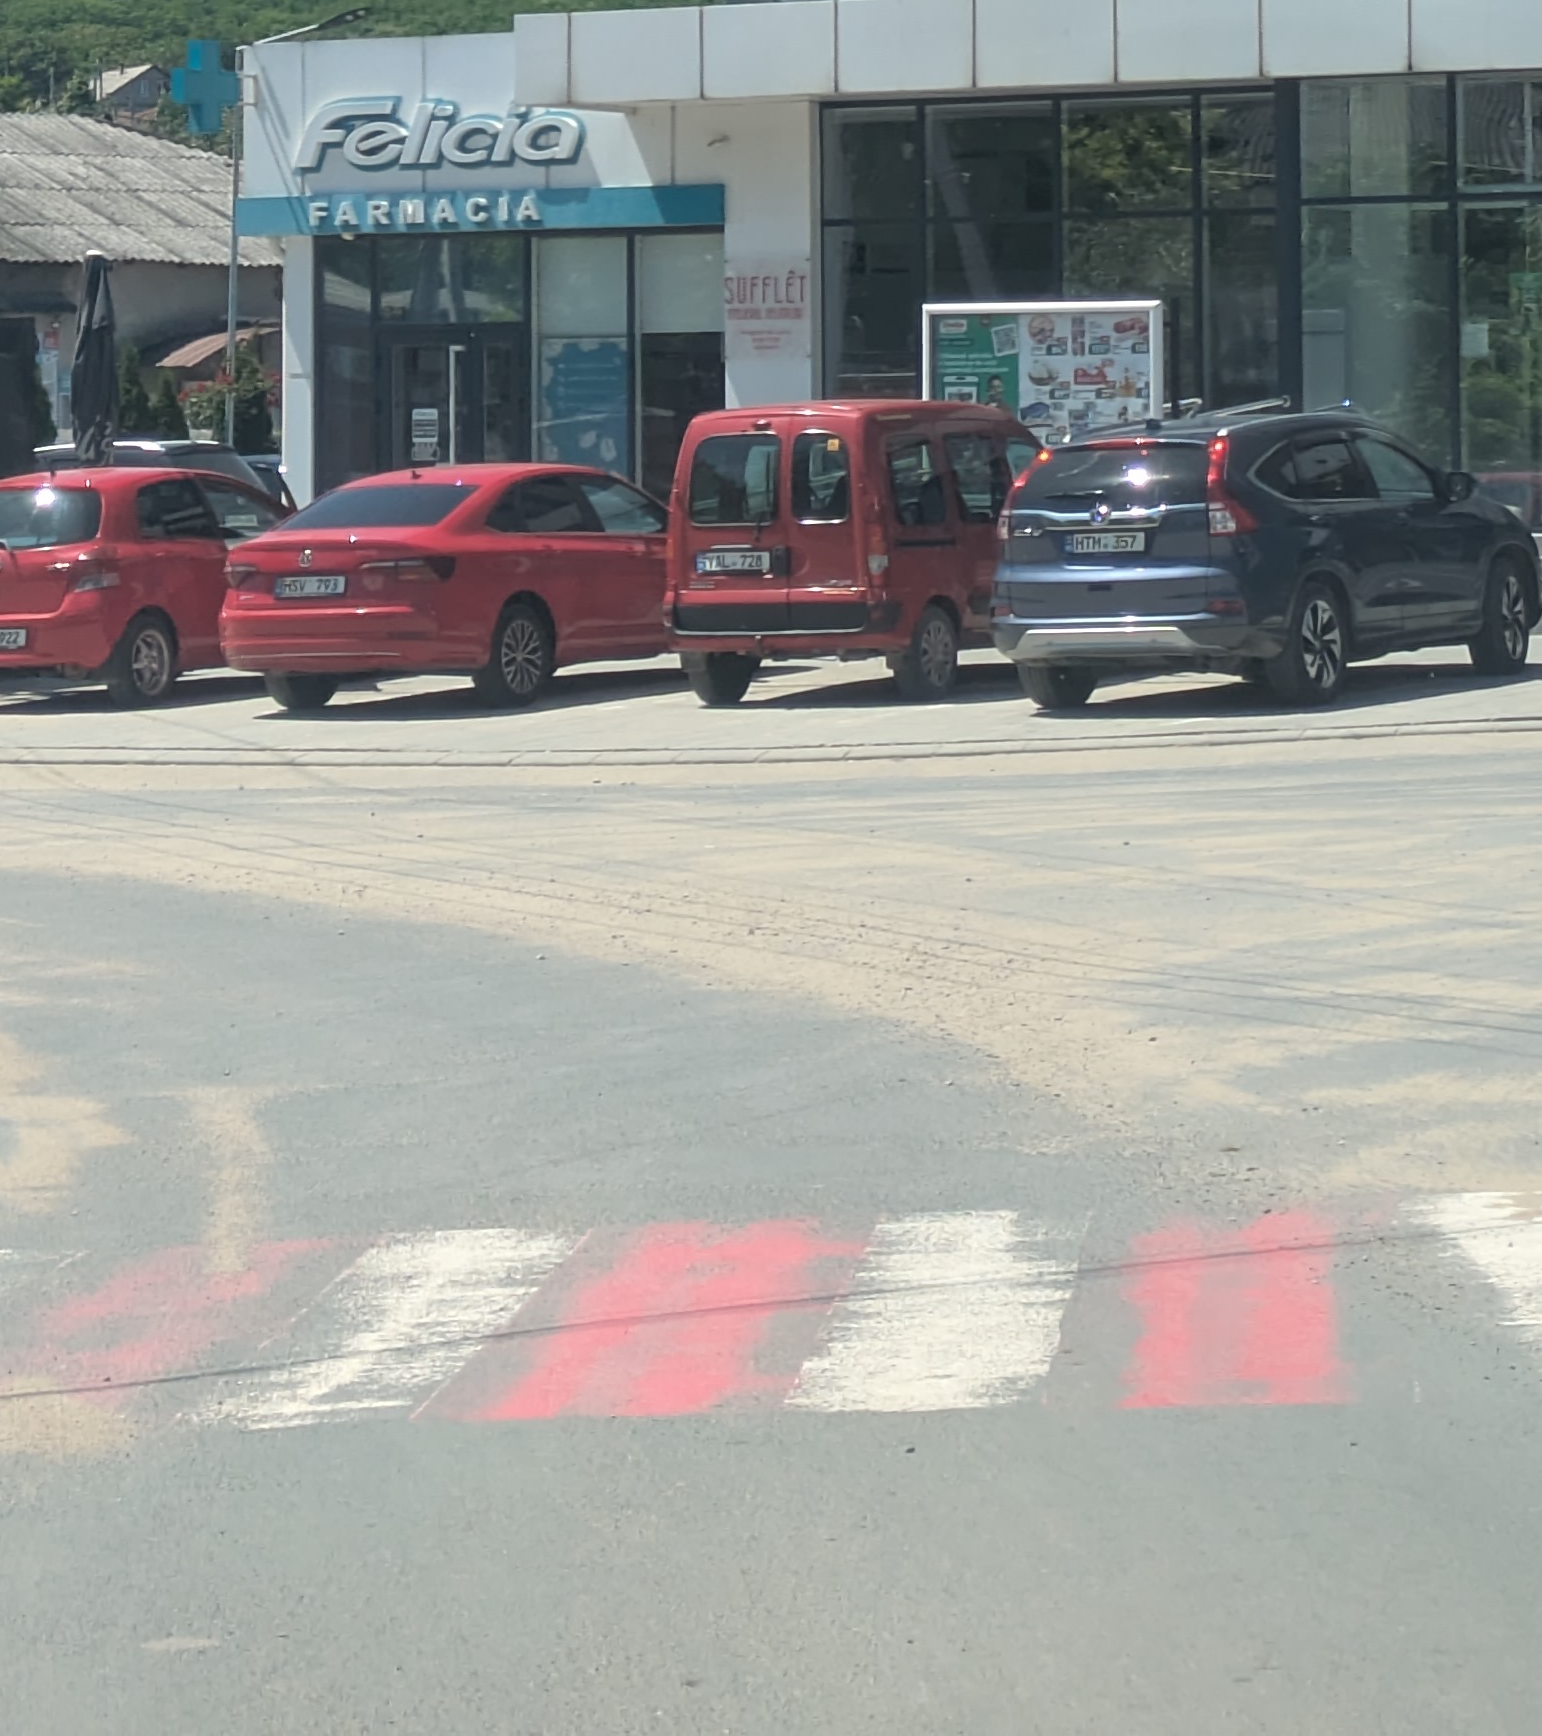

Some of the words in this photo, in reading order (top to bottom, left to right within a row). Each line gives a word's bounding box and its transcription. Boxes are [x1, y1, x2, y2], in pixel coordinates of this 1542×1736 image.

[294, 96, 586, 171] Felicia
[309, 195, 541, 226] FARMACIA
[1113, 535, 1137, 550] 357
[316, 578, 338, 592] 793
